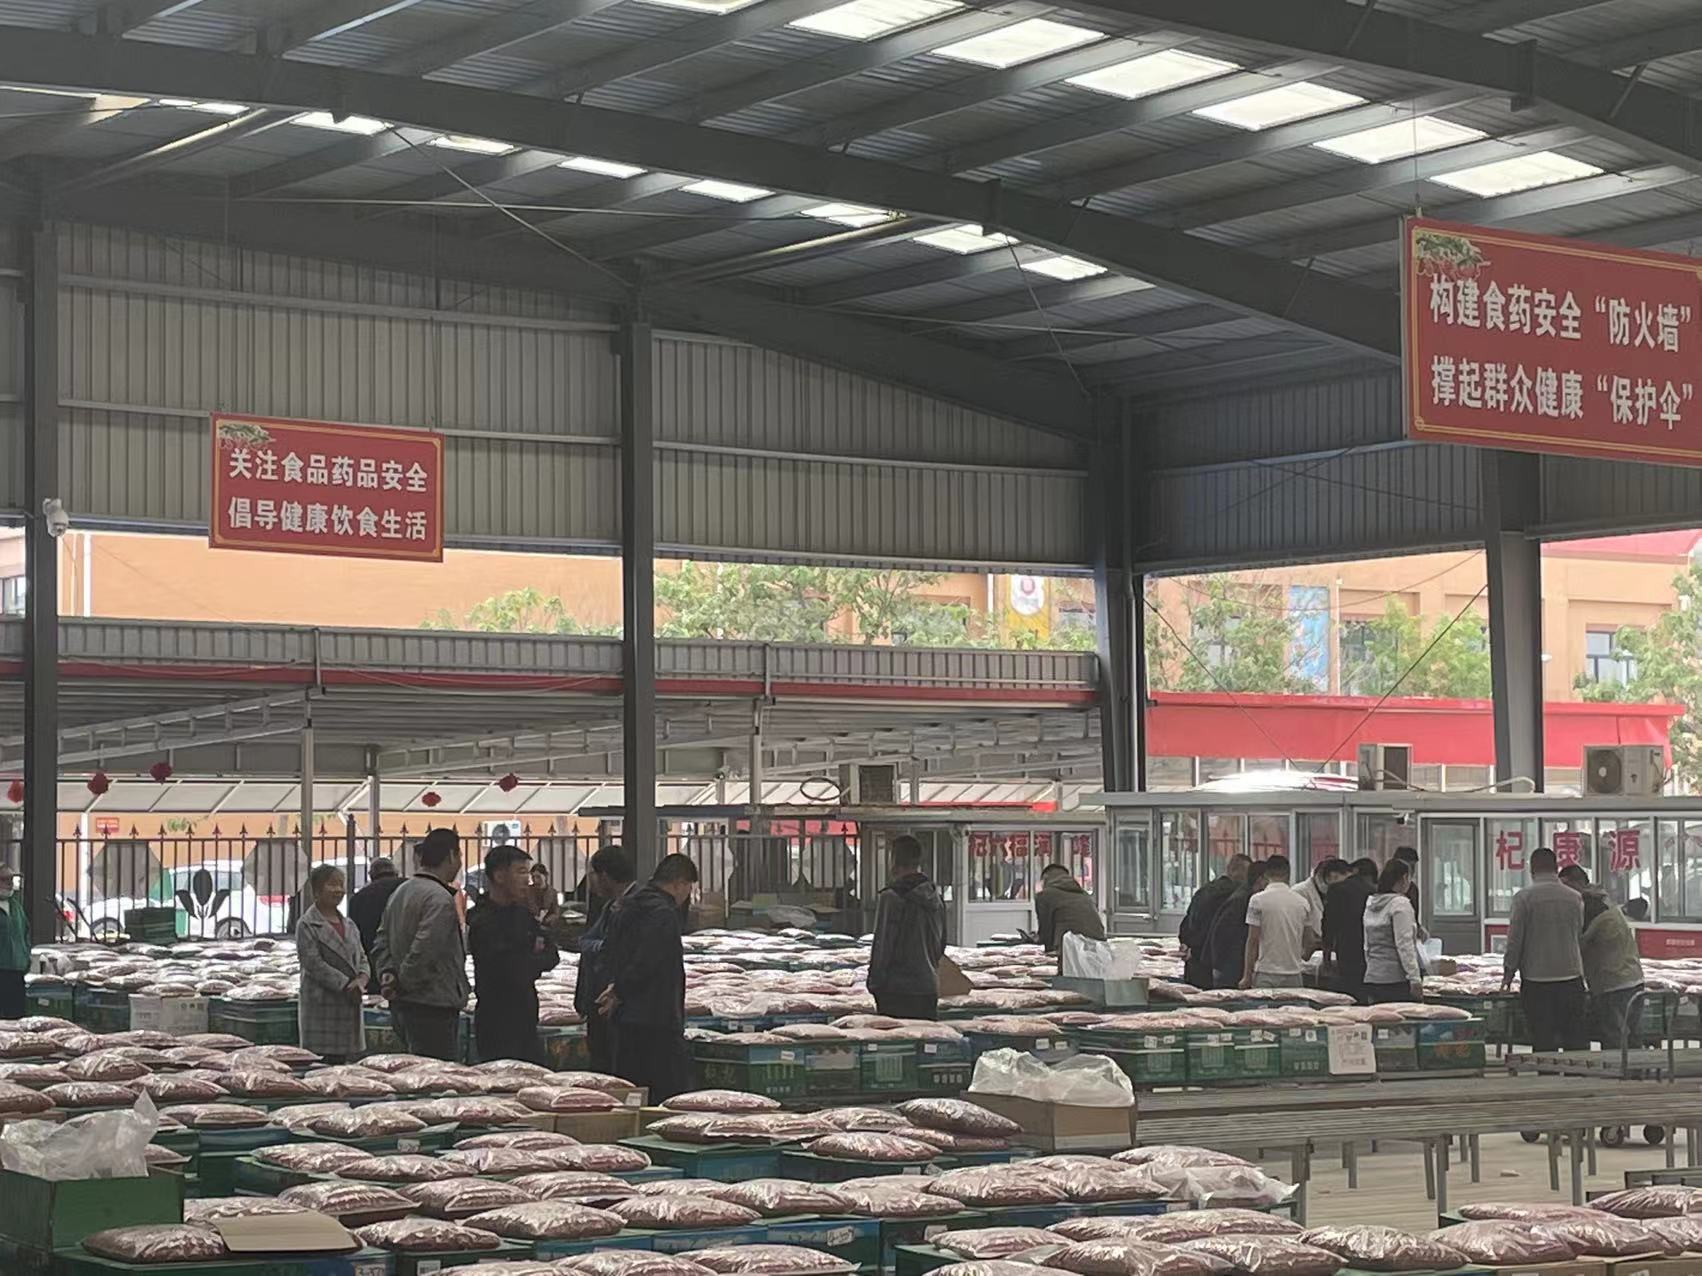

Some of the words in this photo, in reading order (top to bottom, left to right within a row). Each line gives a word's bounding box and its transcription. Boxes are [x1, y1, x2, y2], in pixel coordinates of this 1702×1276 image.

[229, 447, 427, 492] 关注食品药品安全
[228, 496, 427, 541] 倡导健康饮食生活
